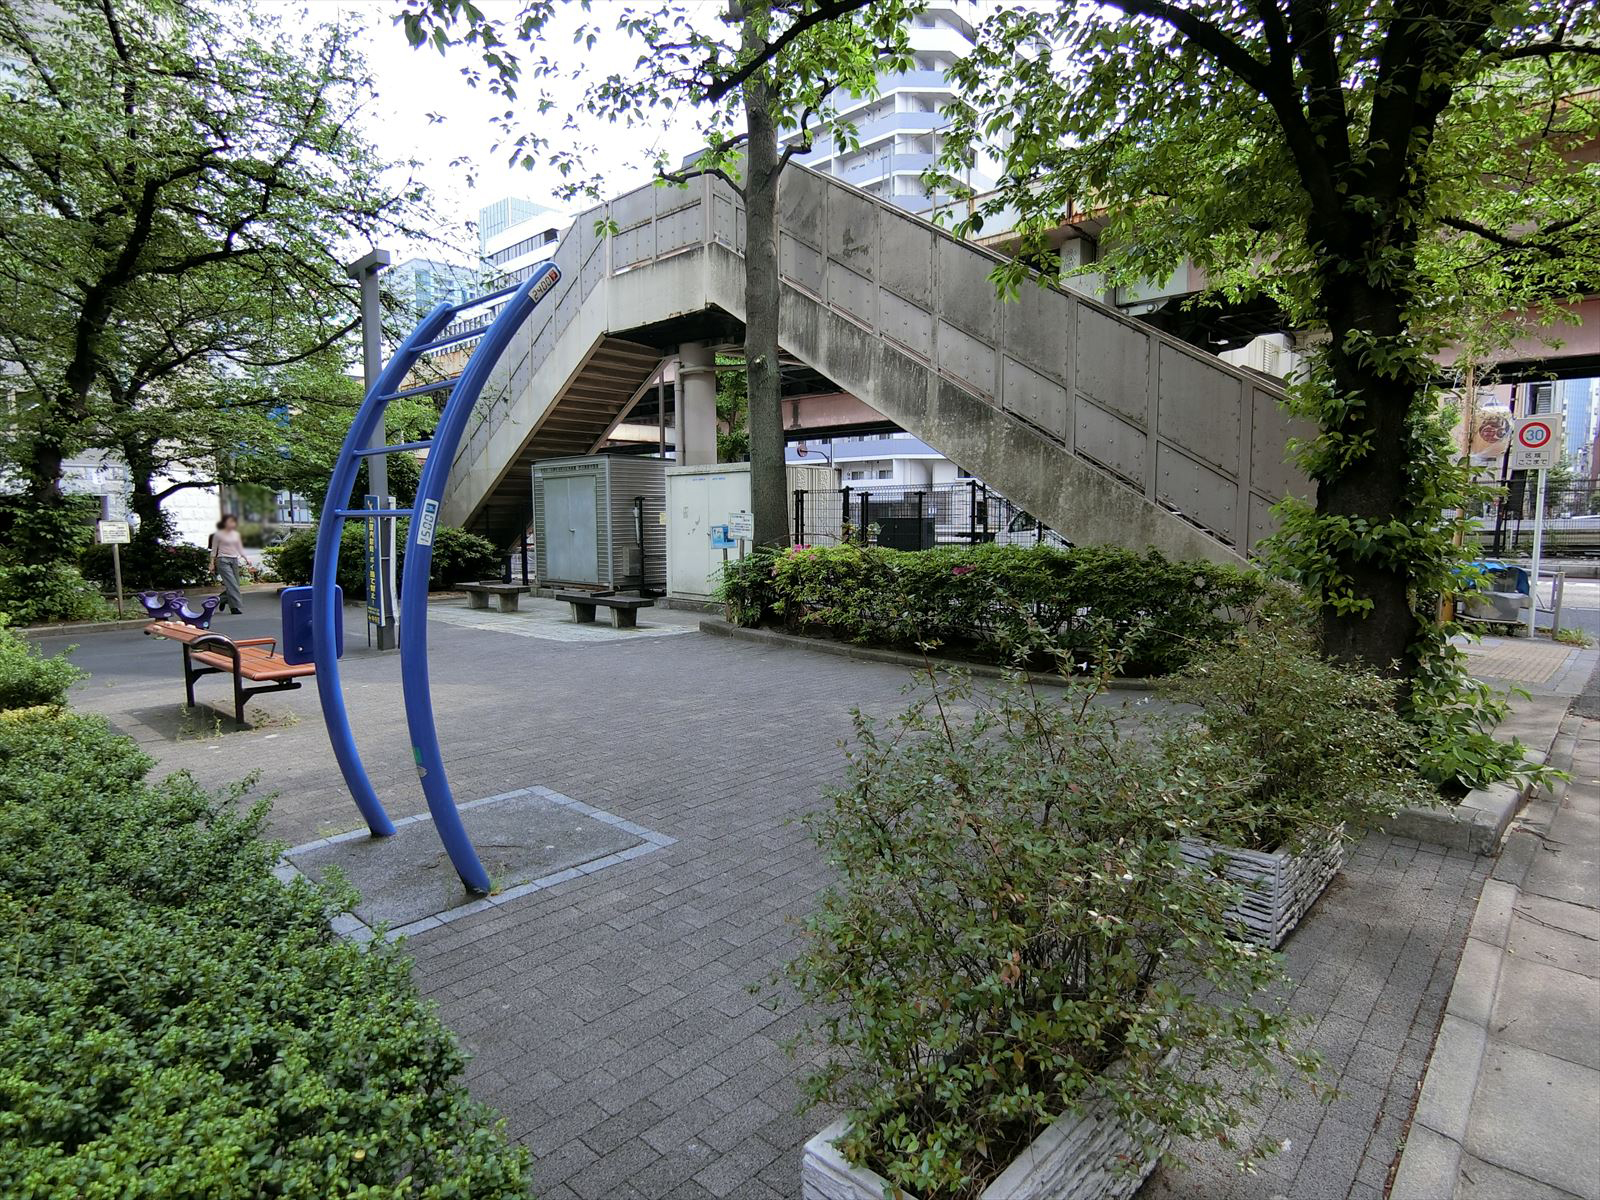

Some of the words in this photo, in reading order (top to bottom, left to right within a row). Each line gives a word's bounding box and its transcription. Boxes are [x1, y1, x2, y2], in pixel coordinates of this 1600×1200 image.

[532, 276, 552, 301] 2400
[1526, 429, 1544, 441] 30
[421, 514, 434, 543] 1500
